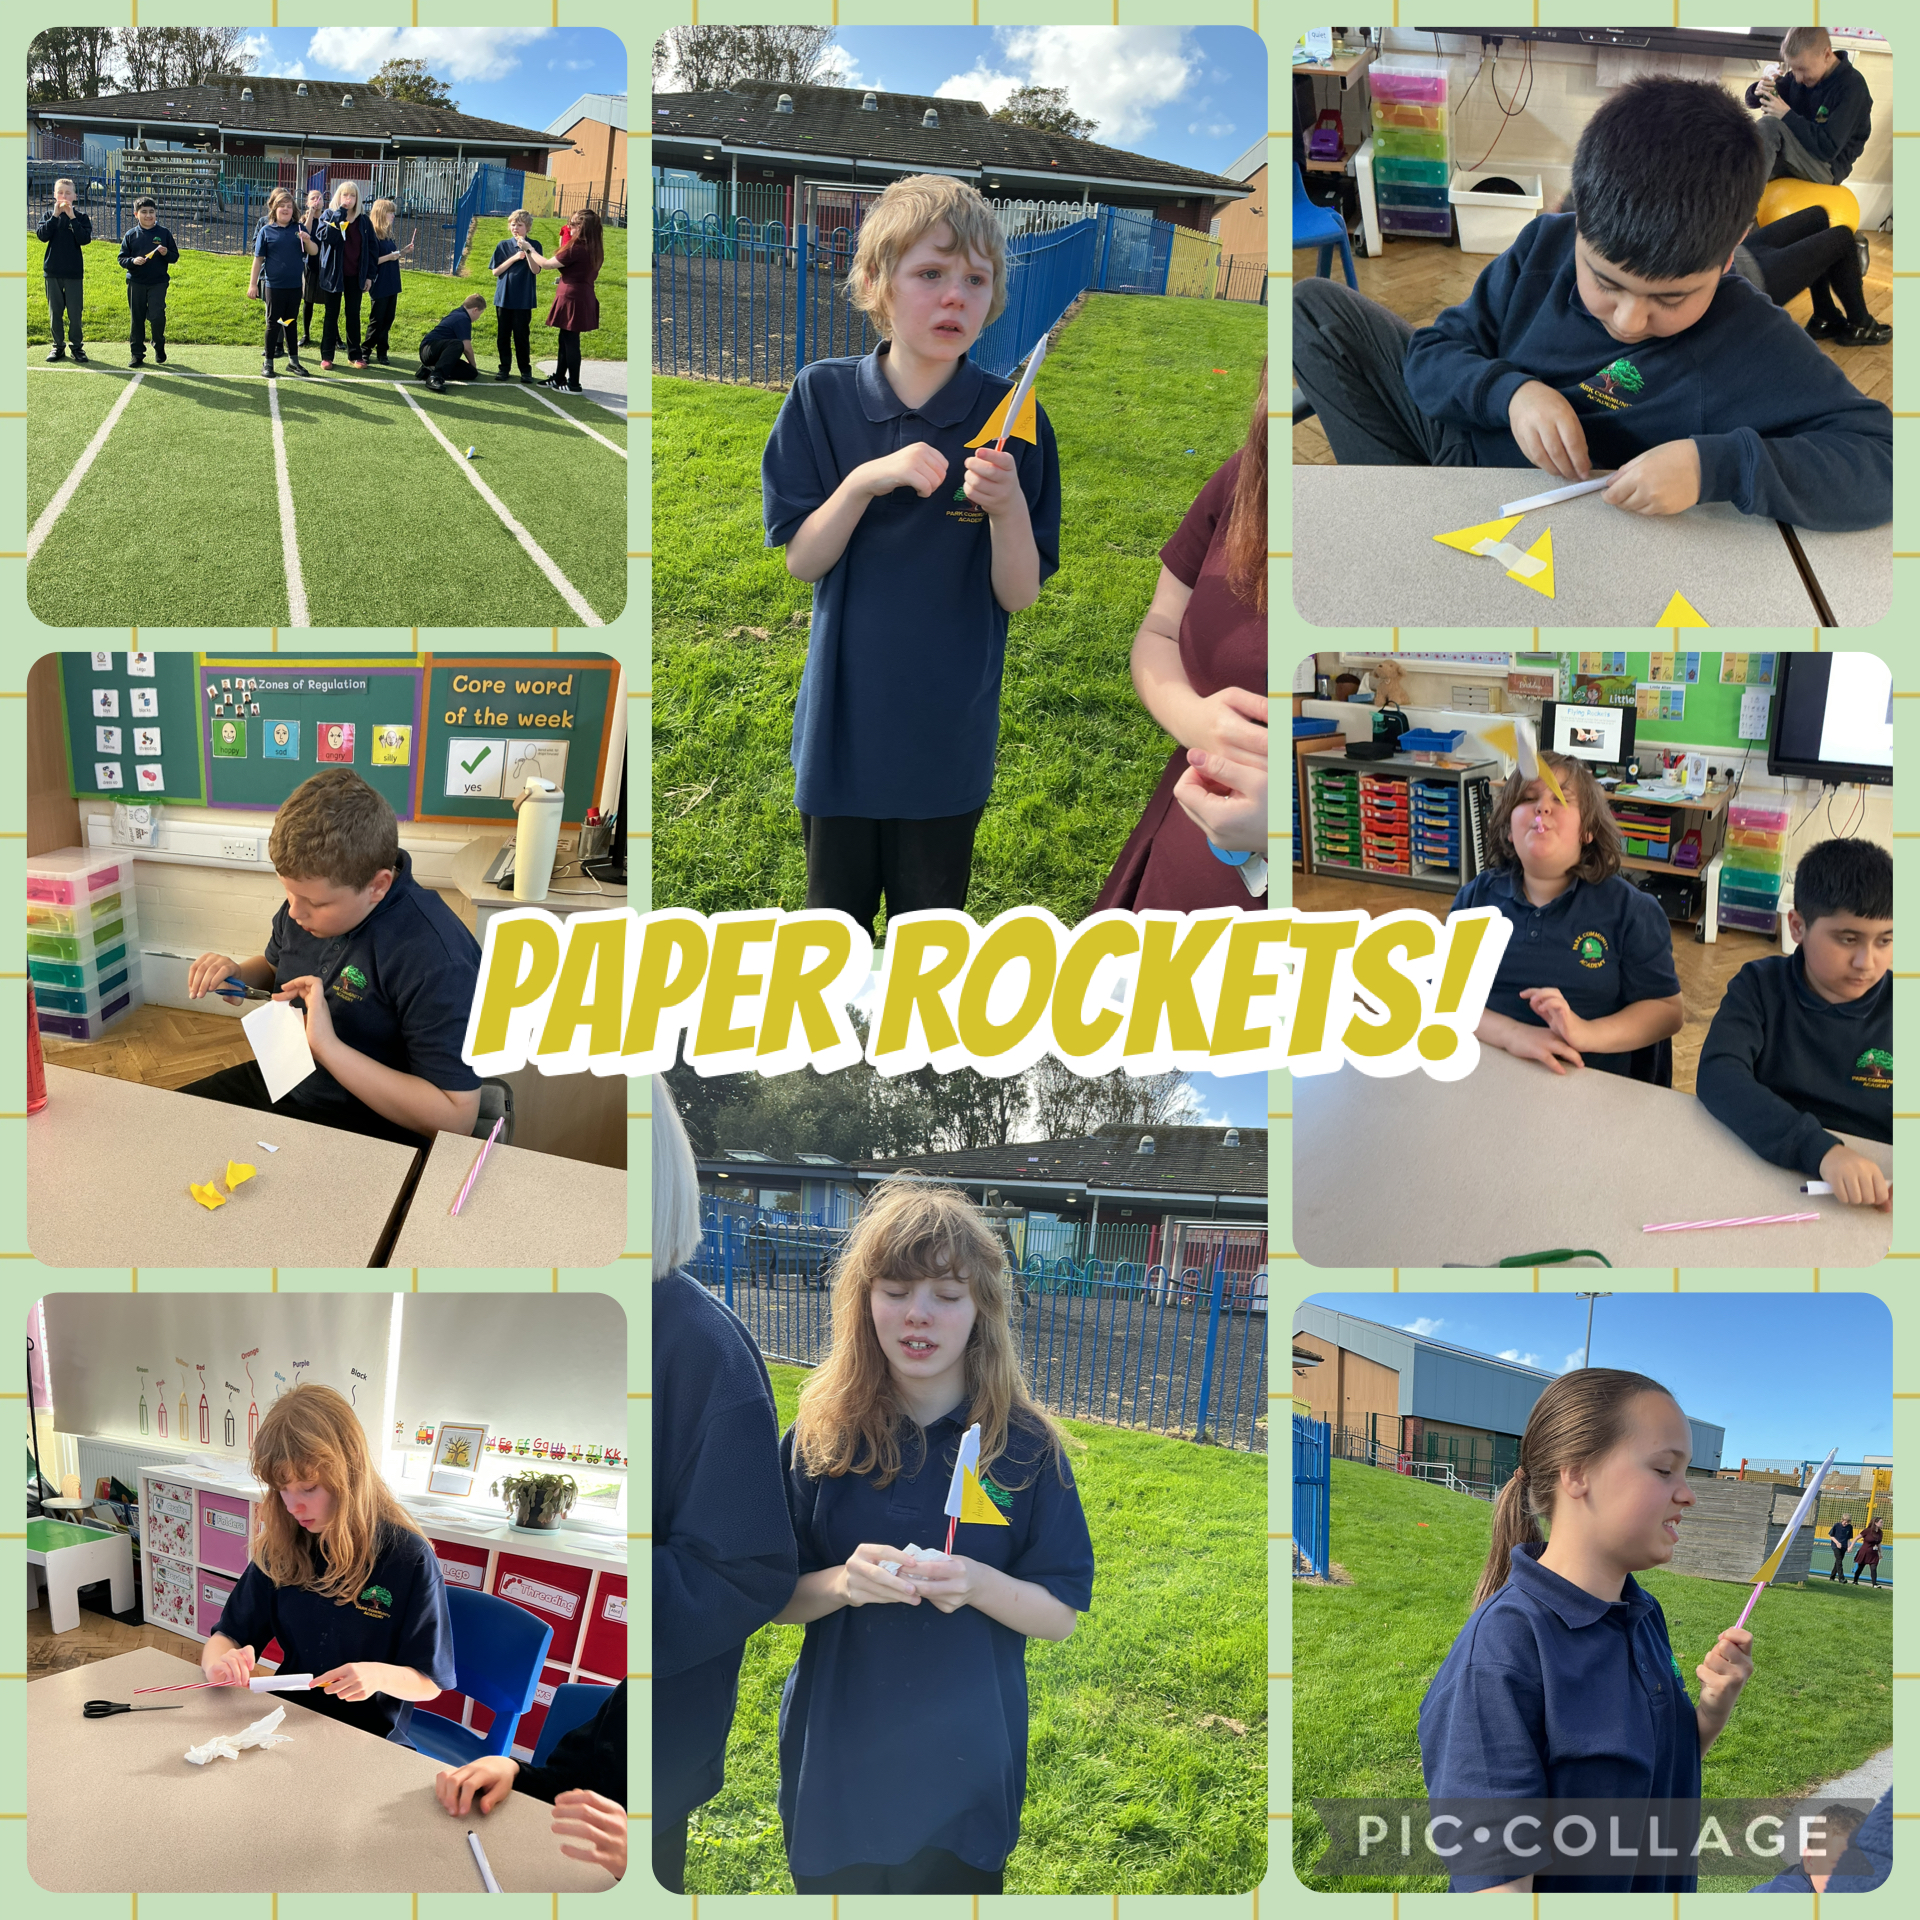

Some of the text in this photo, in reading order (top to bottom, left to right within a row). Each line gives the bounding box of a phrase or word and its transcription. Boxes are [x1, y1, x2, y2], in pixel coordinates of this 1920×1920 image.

[1594, 391, 1632, 408] COMMUNI
[258, 679, 366, 692] Zones of Regulation
[452, 673, 573, 696] Core word
[1609, 694, 1635, 704] Little
[444, 706, 575, 728] of the week
[1567, 708, 1585, 717] Flying
[220, 747, 240, 756] happy
[275, 748, 287, 756] sad
[325, 752, 346, 761] angry
[383, 753, 398, 763] silly
[464, 783, 482, 794] yes
[241, 1347, 259, 1360] Orange
[196, 1363, 205, 1371] Red
[292, 1359, 310, 1368] Purple
[274, 1370, 286, 1382] Blue
[350, 1367, 367, 1381] Black
[225, 1381, 240, 1393] Brown
[166, 1502, 188, 1516] Crafts
[217, 1515, 245, 1530] Folders
[443, 1564, 470, 1580] Lego
[521, 1584, 575, 1613] Threading
